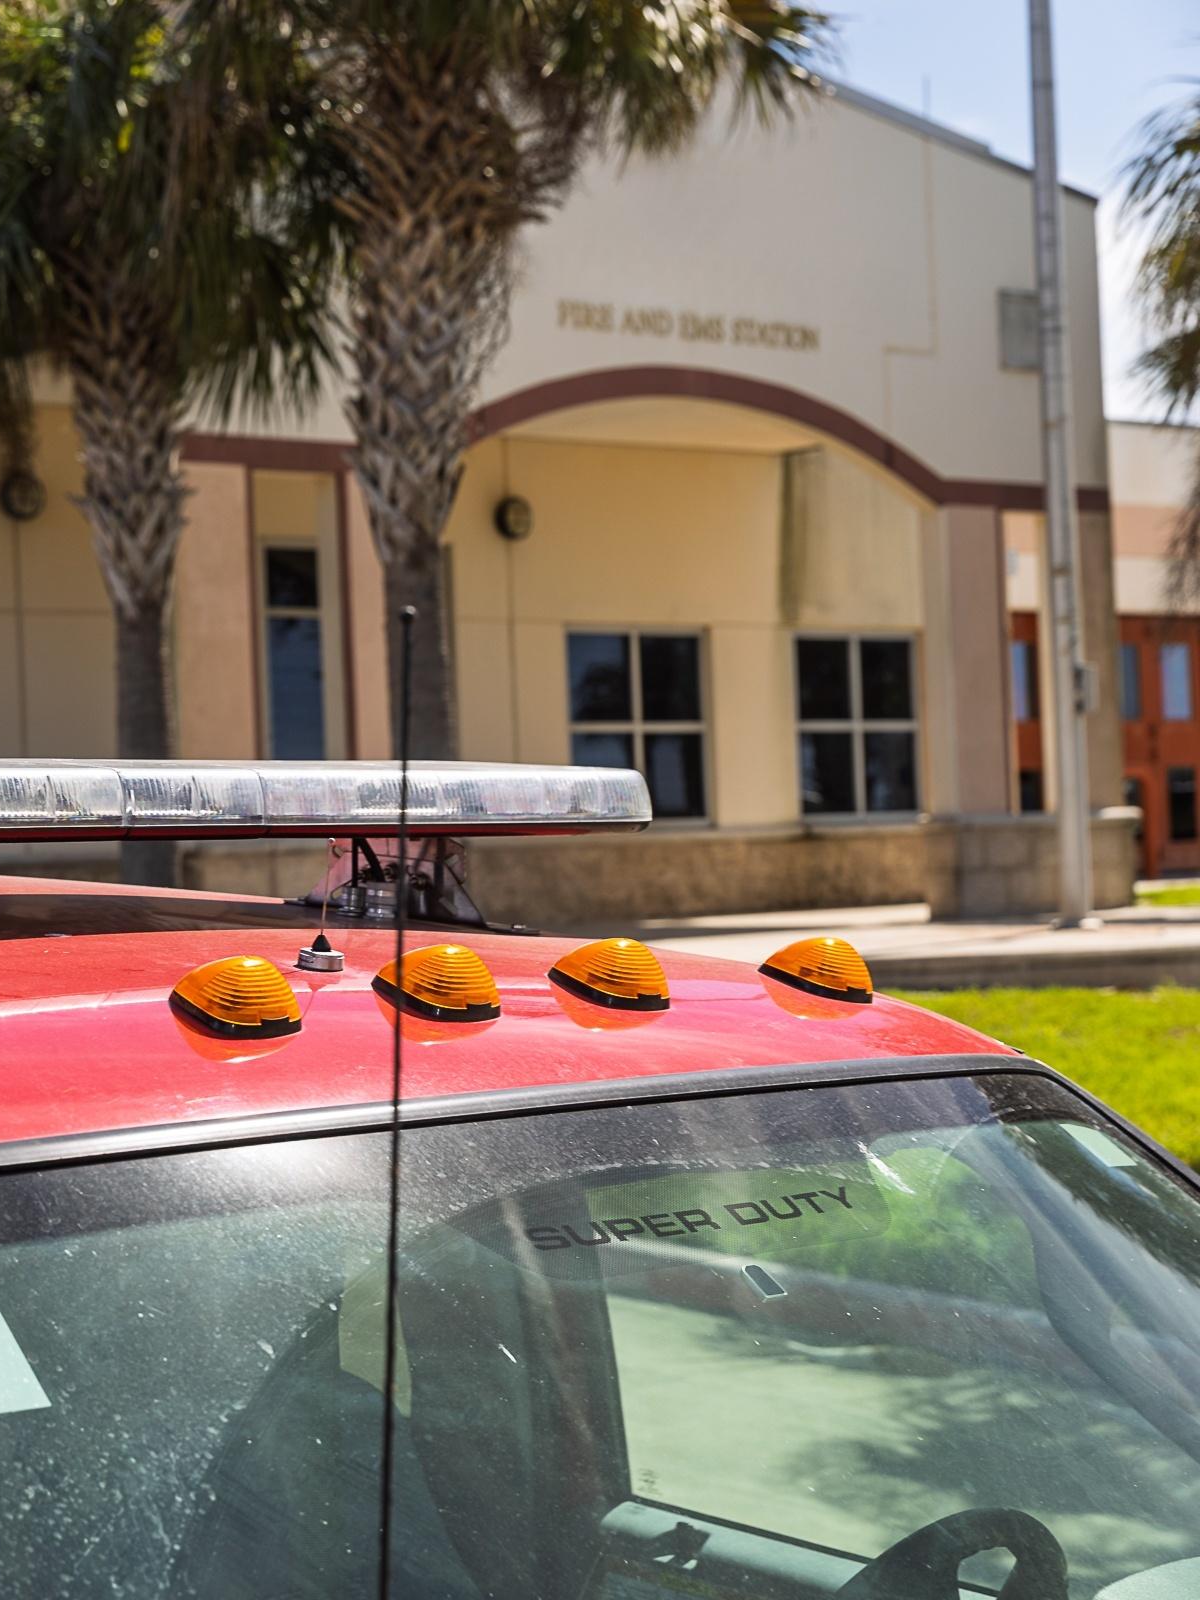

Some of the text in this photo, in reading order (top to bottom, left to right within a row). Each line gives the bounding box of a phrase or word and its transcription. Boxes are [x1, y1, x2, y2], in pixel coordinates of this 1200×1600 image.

[557, 299, 613, 332] FIRE
[619, 307, 673, 338] AND
[730, 317, 820, 351] STATION
[526, 1186, 853, 1251] SUPER DUTY
